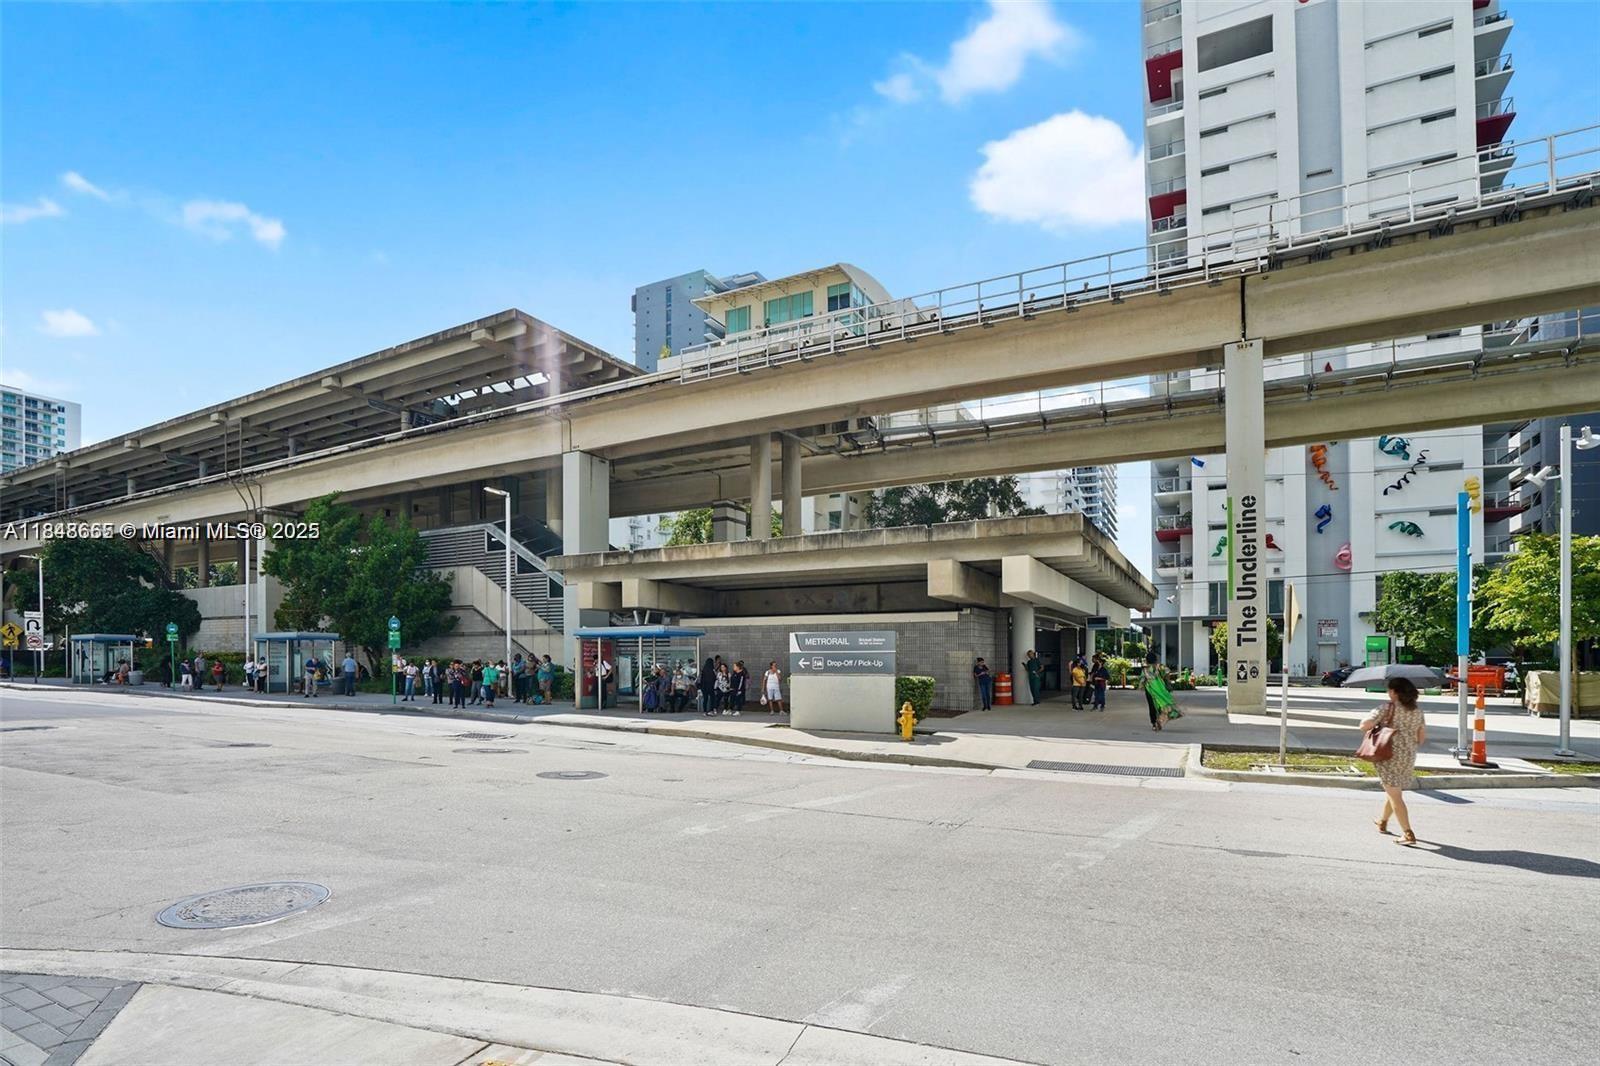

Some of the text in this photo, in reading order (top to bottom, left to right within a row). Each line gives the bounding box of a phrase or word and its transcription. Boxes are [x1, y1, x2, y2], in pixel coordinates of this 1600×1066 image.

[1236, 495, 1257, 601] Underline
[1236, 606, 1257, 647] The
[805, 637, 850, 646] METRORAIL
[827, 659, 853, 668] Drop-Off
[858, 659, 884, 668] Pick-Up
